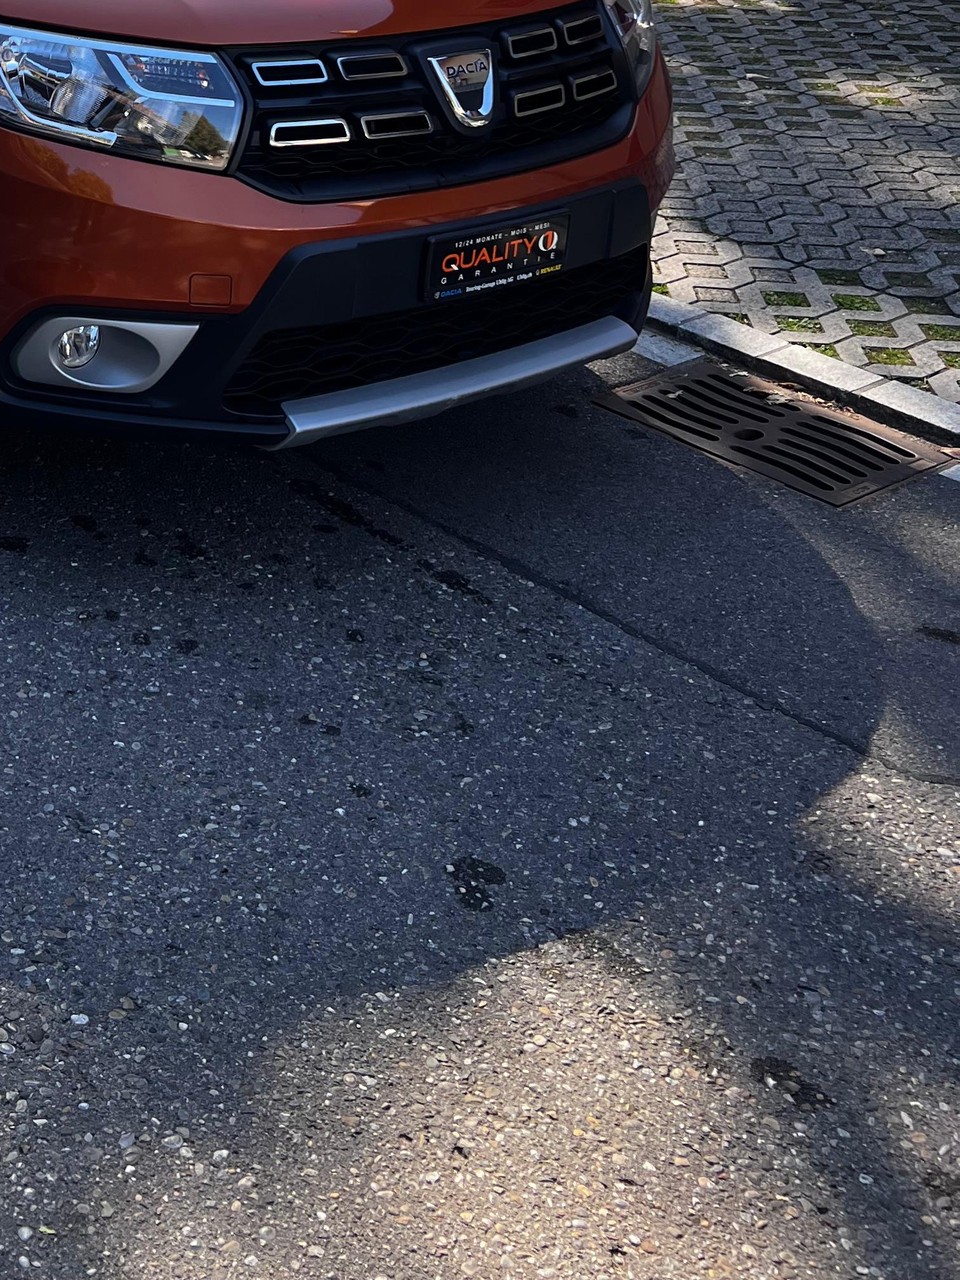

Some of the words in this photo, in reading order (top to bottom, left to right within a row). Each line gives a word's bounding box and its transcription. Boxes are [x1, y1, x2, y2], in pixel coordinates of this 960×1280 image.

[446, 61, 488, 76] DACIA
[455, 238, 474, 248] 12/24
[476, 232, 503, 244] MONATE
[510, 227, 527, 238] MOIS
[534, 222, 550, 231] MESI
[441, 235, 538, 273] QUALITY
[440, 252, 556, 285] GARANTIE
[440, 287, 462, 298] DACIA
